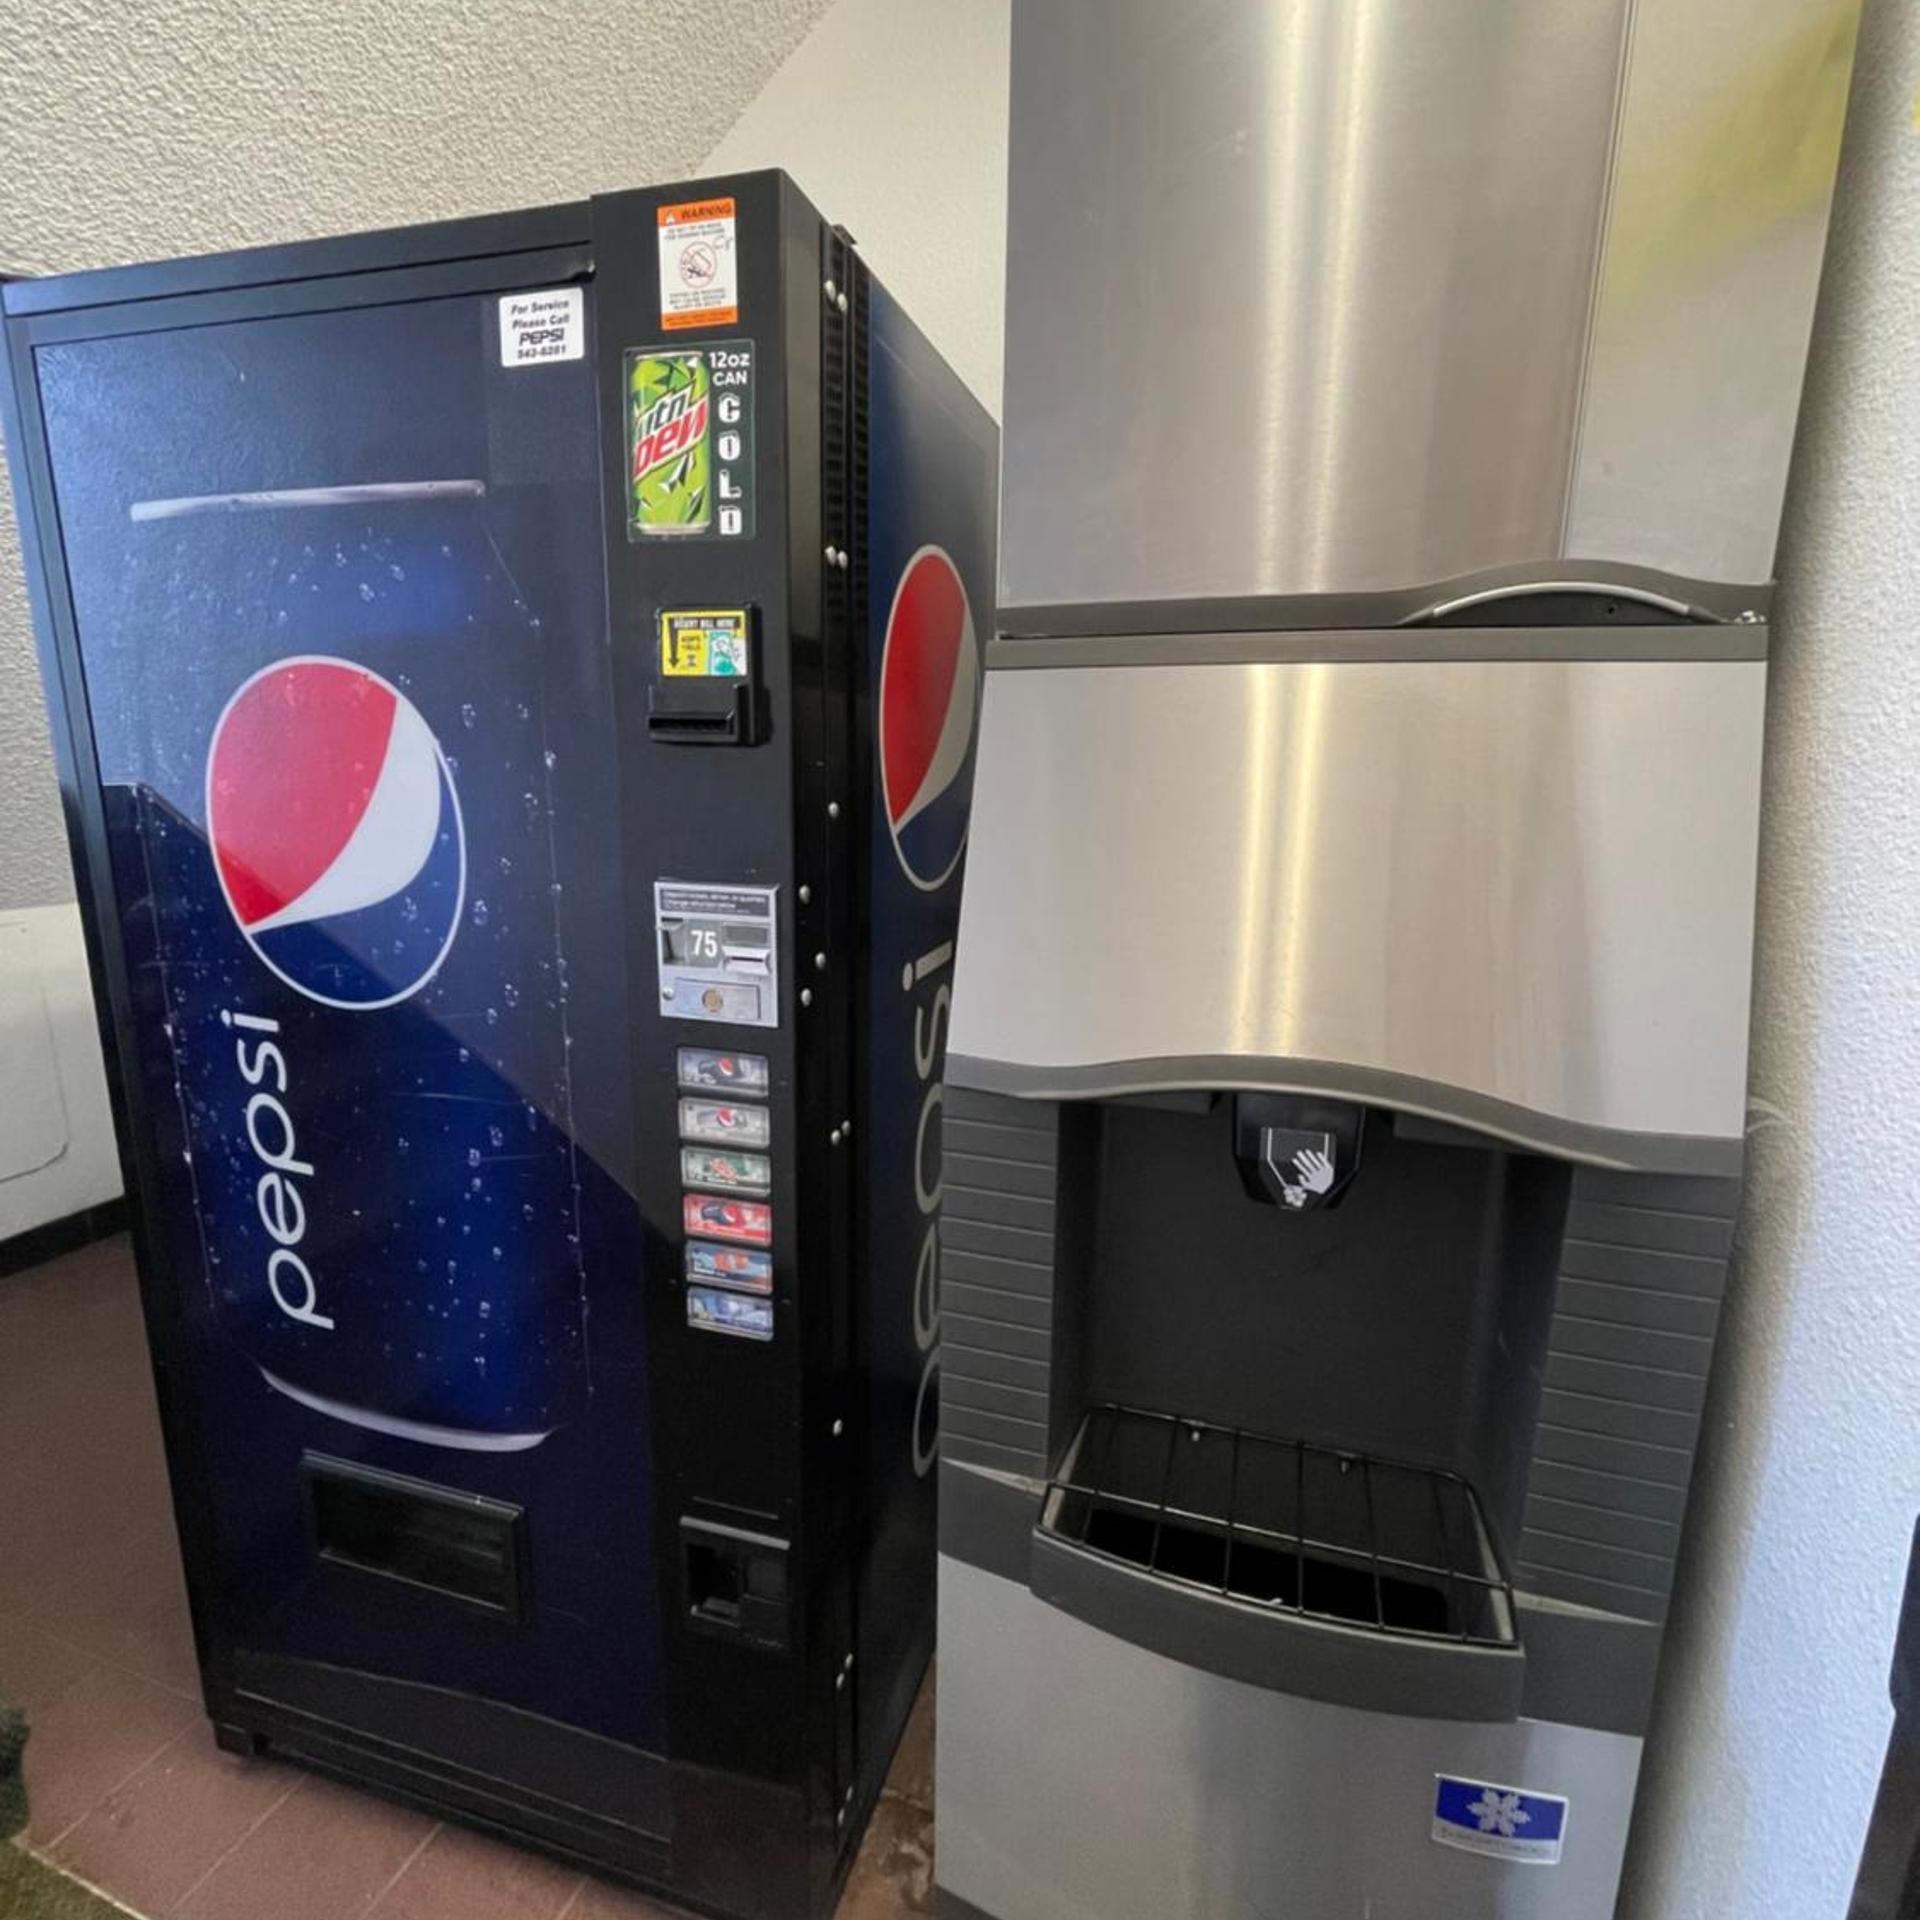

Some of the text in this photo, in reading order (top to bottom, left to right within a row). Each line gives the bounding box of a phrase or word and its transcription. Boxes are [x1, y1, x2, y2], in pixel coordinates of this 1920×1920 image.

[511, 301, 569, 315] For Service
[512, 314, 570, 330] Please Call
[519, 328, 564, 346] PEPSI
[709, 352, 750, 368] 12oz
[713, 371, 748, 386] CAN
[691, 930, 718, 958] 75
[220, 1009, 335, 1330] pepsi
